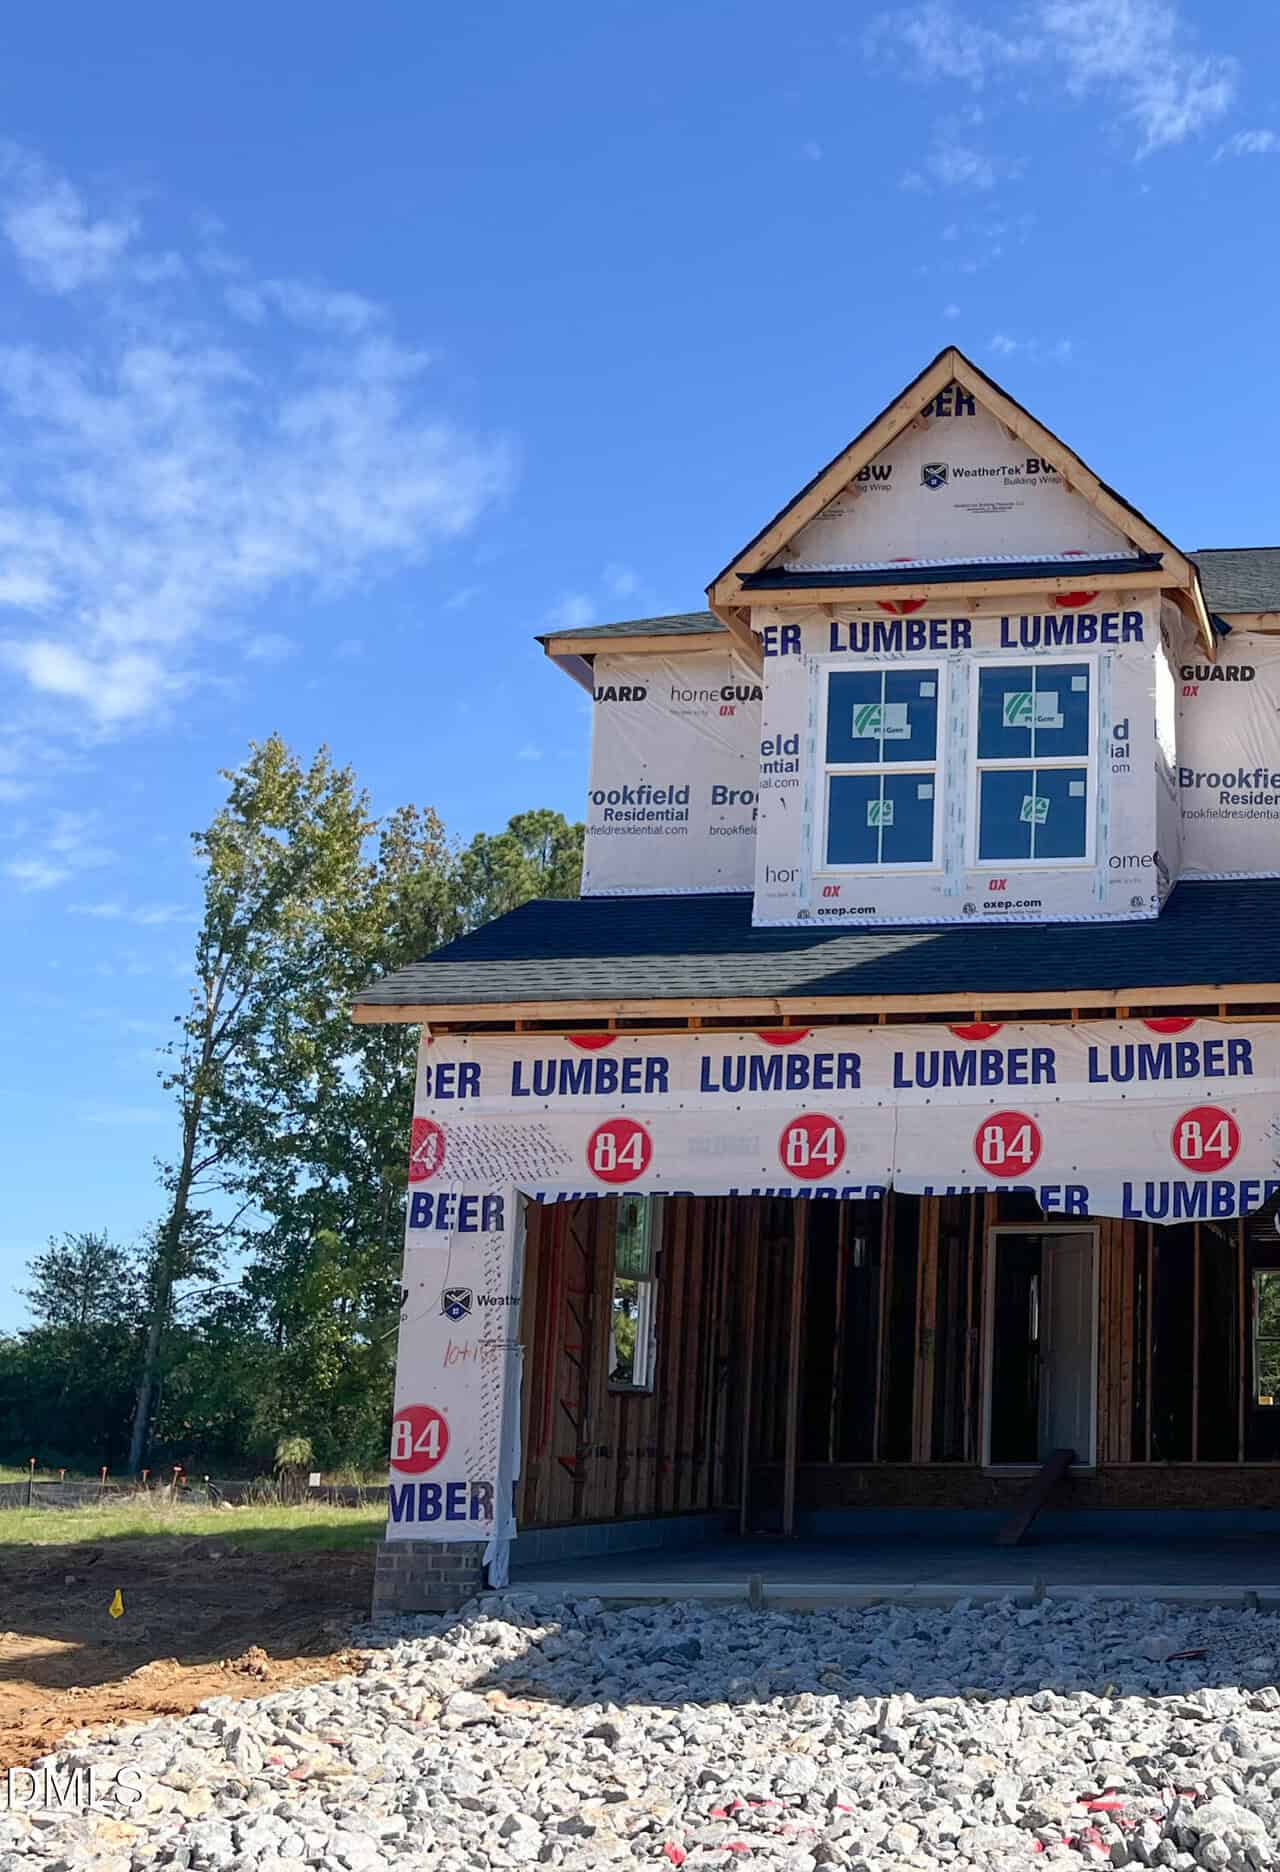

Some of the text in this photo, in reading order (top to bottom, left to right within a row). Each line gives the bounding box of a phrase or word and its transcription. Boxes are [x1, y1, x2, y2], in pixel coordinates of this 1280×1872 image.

[952, 464, 1022, 479] WeatherTek
[1003, 477, 1035, 487] Building
[829, 618, 972, 653] LUMBER
[1000, 611, 1145, 648] LUMBER
[1180, 664, 1256, 682] GUARD
[603, 808, 689, 822] Residential
[817, 898, 1042, 917] oxep.com oxep.com
[511, 1056, 670, 1097] LUMBER
[699, 1052, 862, 1093] LUMBER
[893, 1047, 1056, 1089] LUMBER
[1088, 1038, 1254, 1083] LUMBER
[593, 1131, 645, 1172] 84
[786, 1127, 839, 1167] 84
[981, 1124, 1035, 1165] 84
[1179, 1118, 1233, 1160] 84
